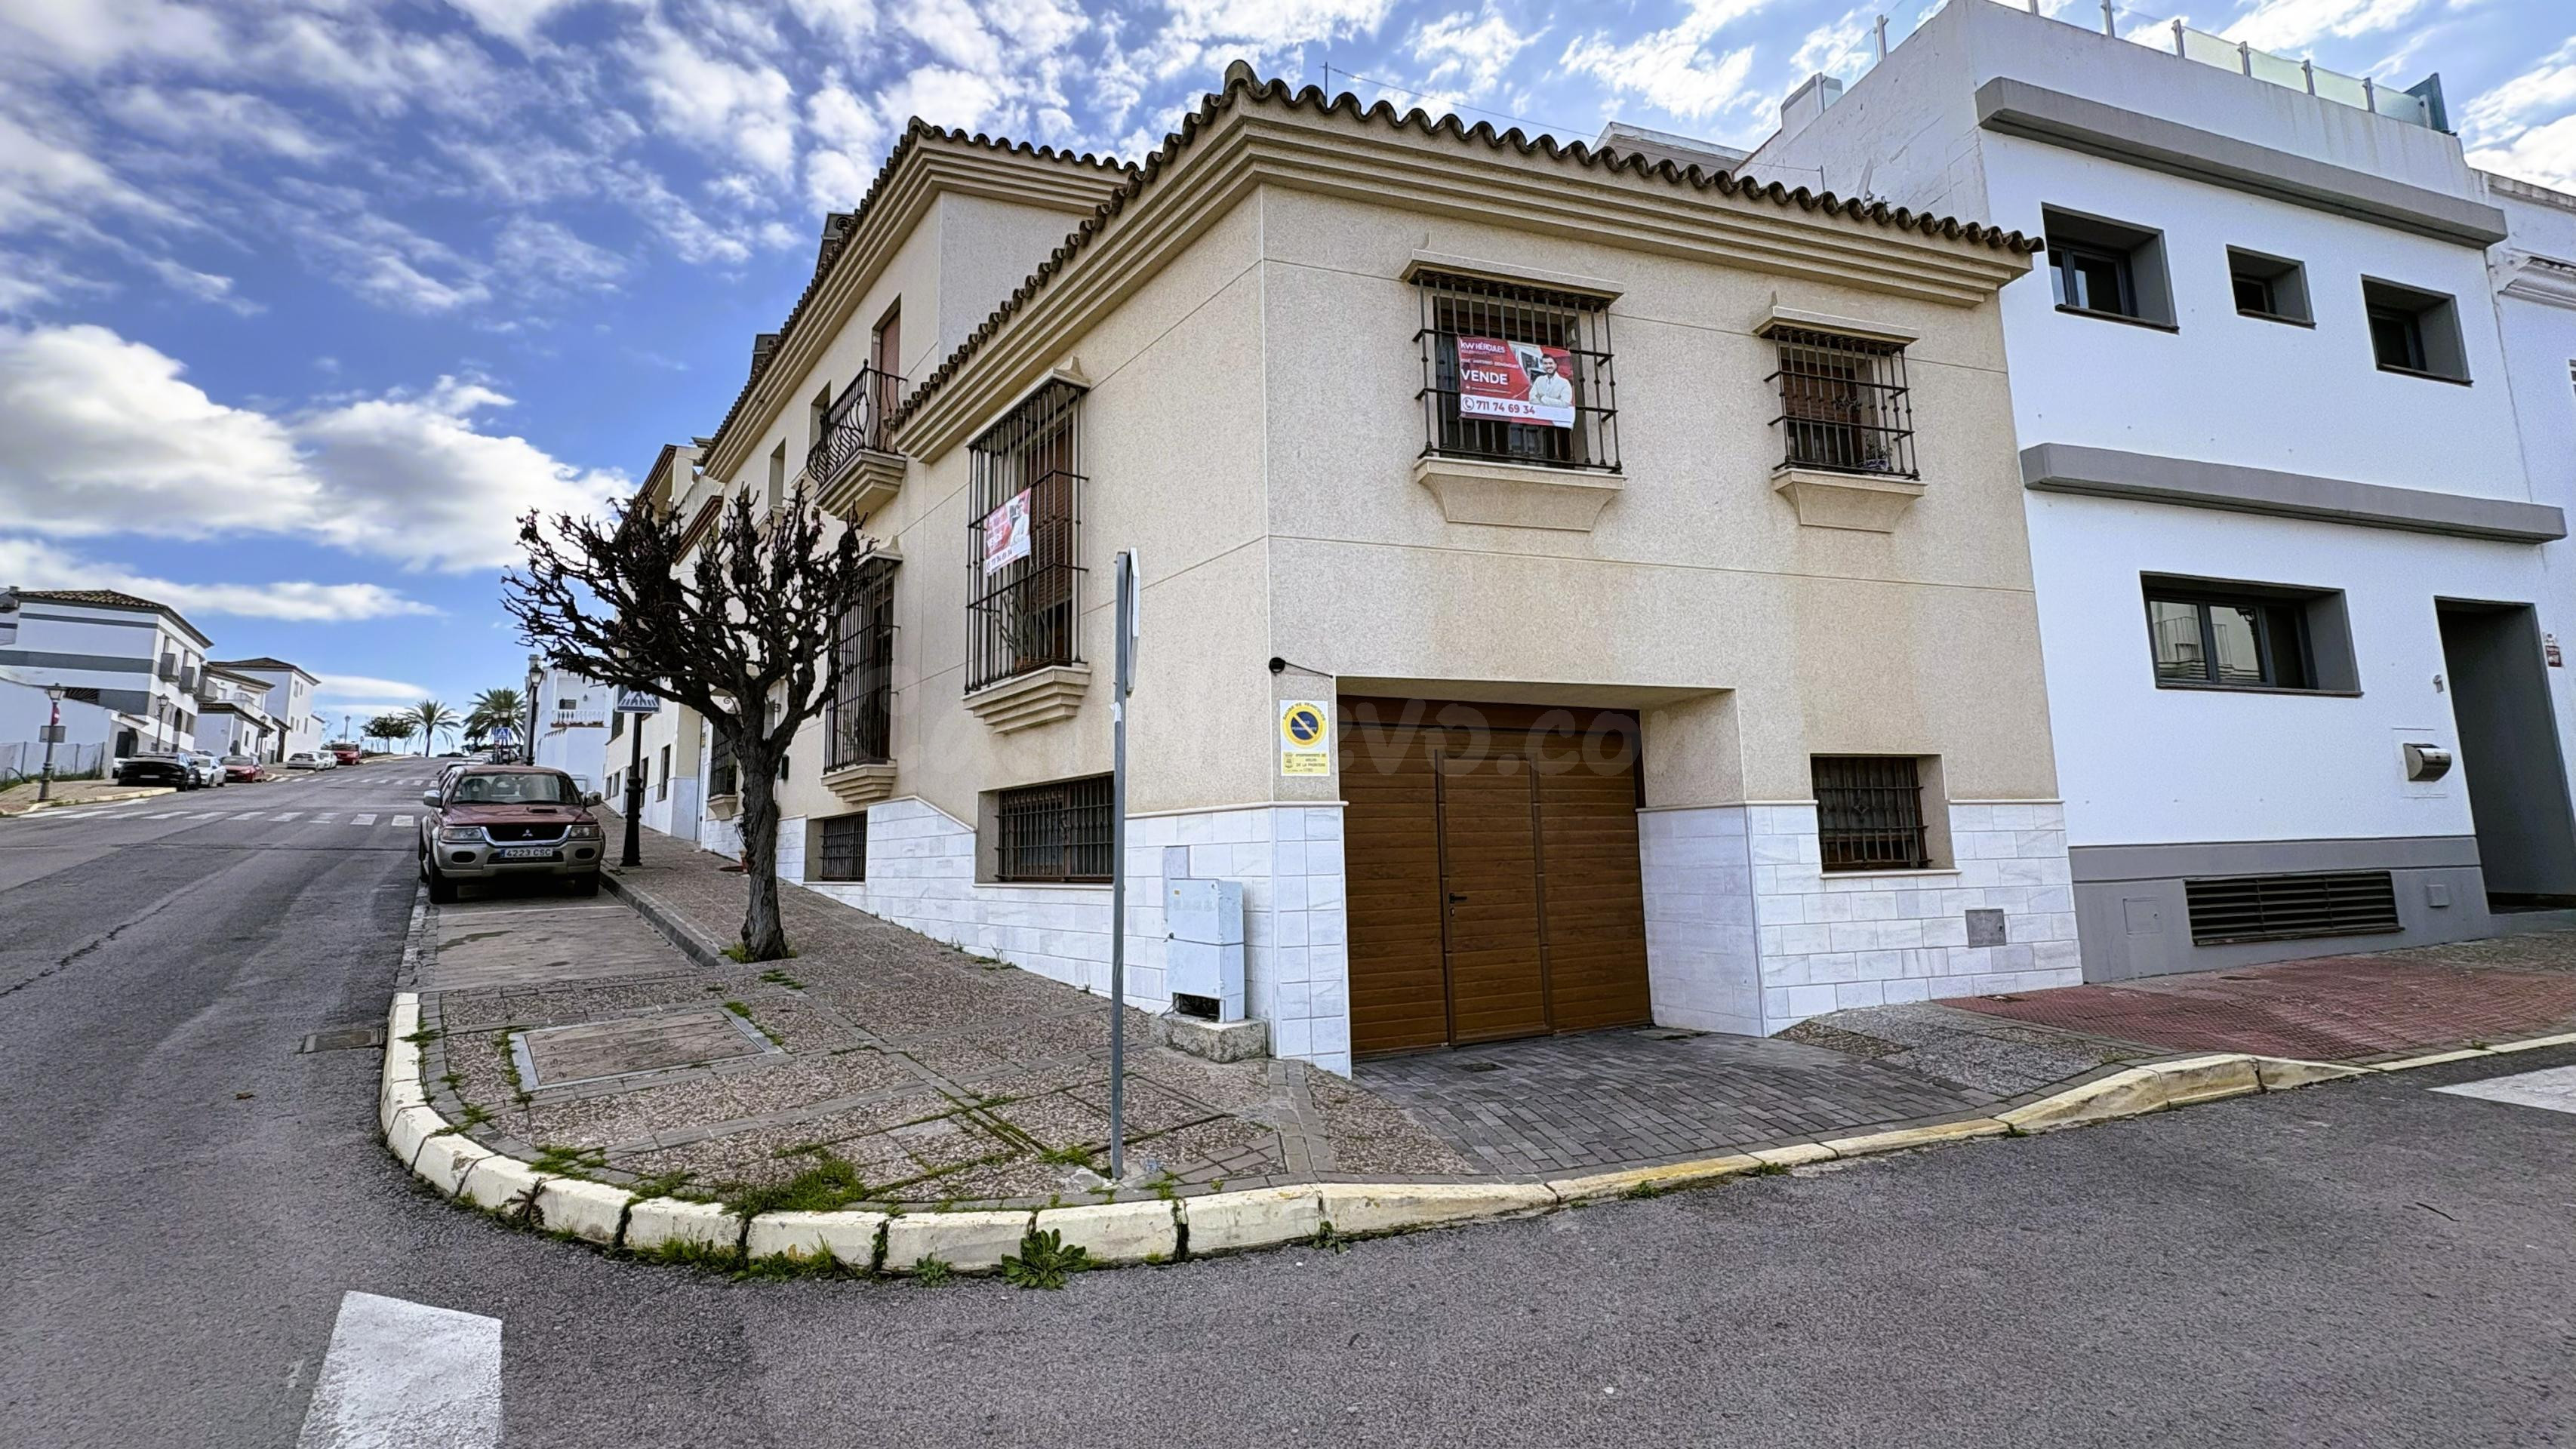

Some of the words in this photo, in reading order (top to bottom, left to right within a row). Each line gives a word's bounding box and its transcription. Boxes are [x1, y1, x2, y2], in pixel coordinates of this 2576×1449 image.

[1461, 369, 1509, 386] VENDE
[1476, 400, 1490, 411] 711
[1493, 402, 1505, 412] 74
[1508, 404, 1520, 414] 69
[1523, 405, 1536, 414] 34
